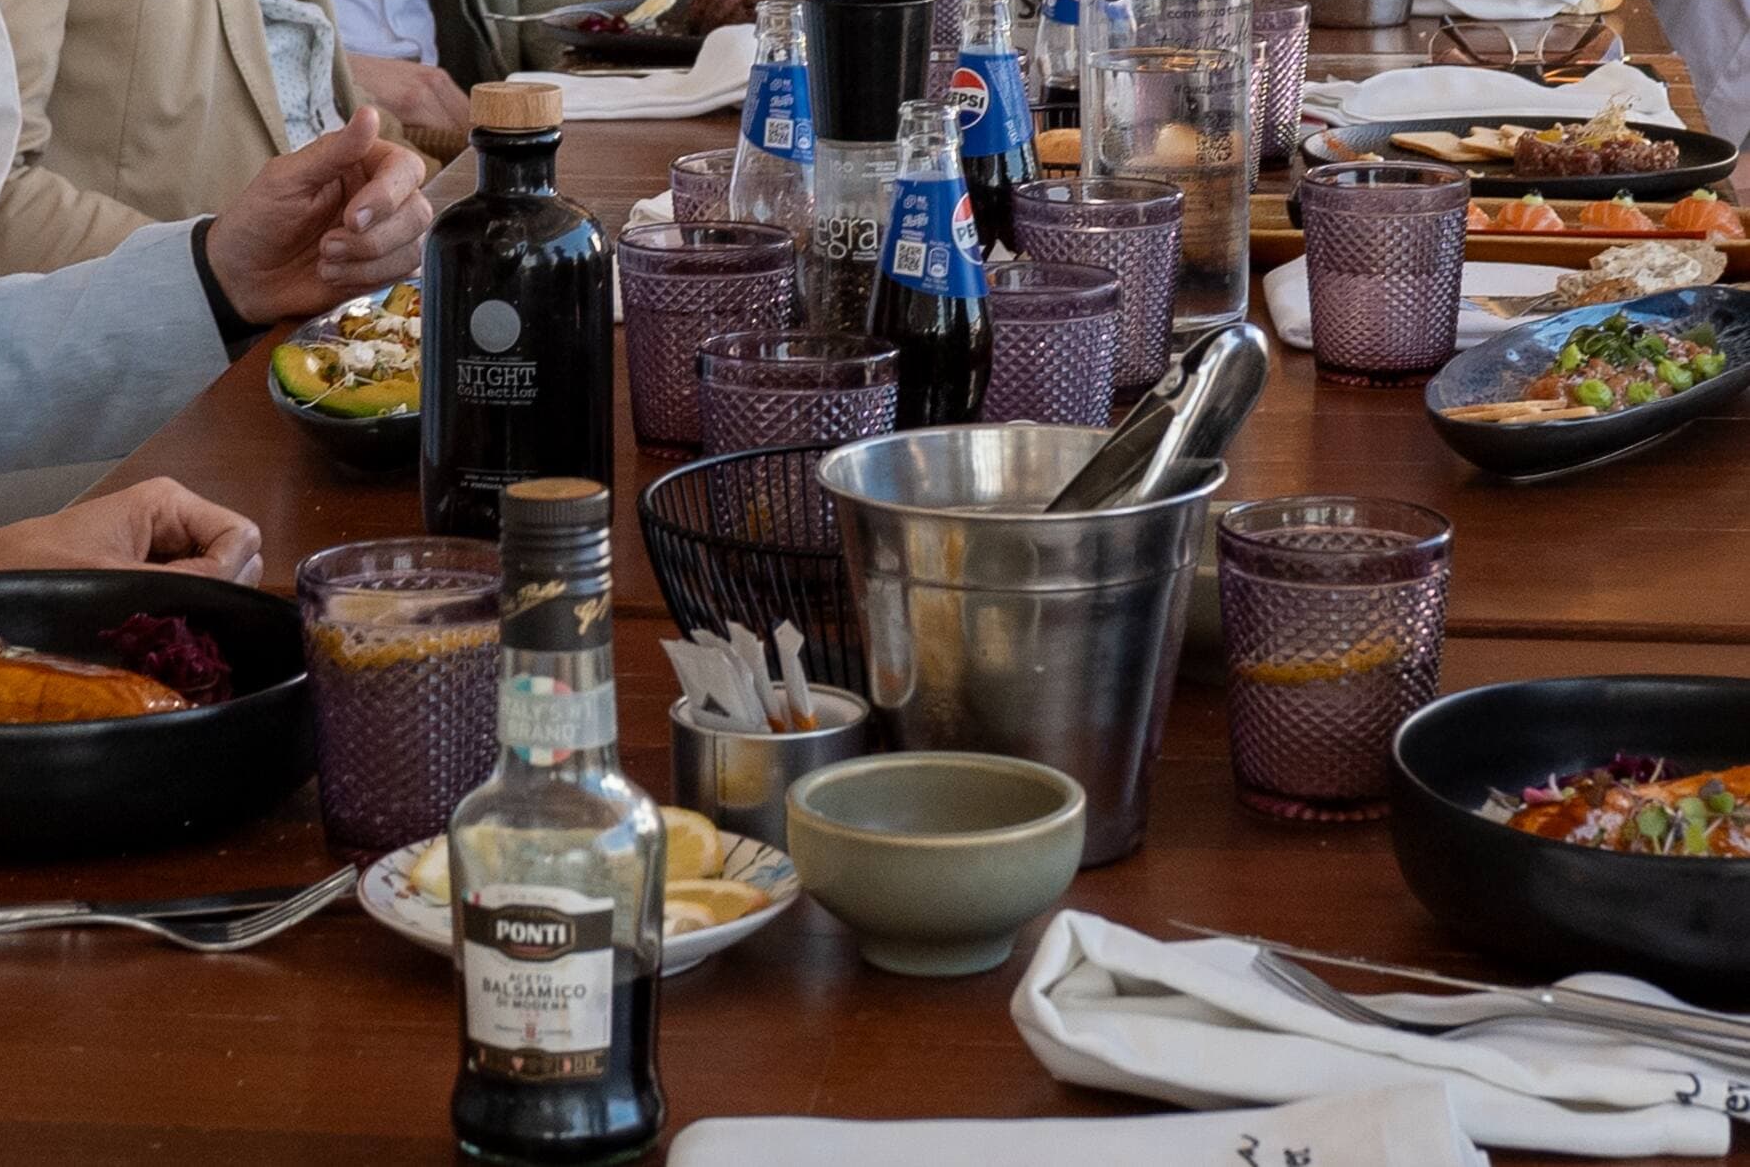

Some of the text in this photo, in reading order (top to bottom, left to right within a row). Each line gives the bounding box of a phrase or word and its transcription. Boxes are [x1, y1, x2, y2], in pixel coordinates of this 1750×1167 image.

[457, 364, 537, 387] NIGHT
[496, 919, 567, 945] PONTI
[482, 976, 587, 1000] BALSAMICO
[509, 972, 554, 983] ACETO
